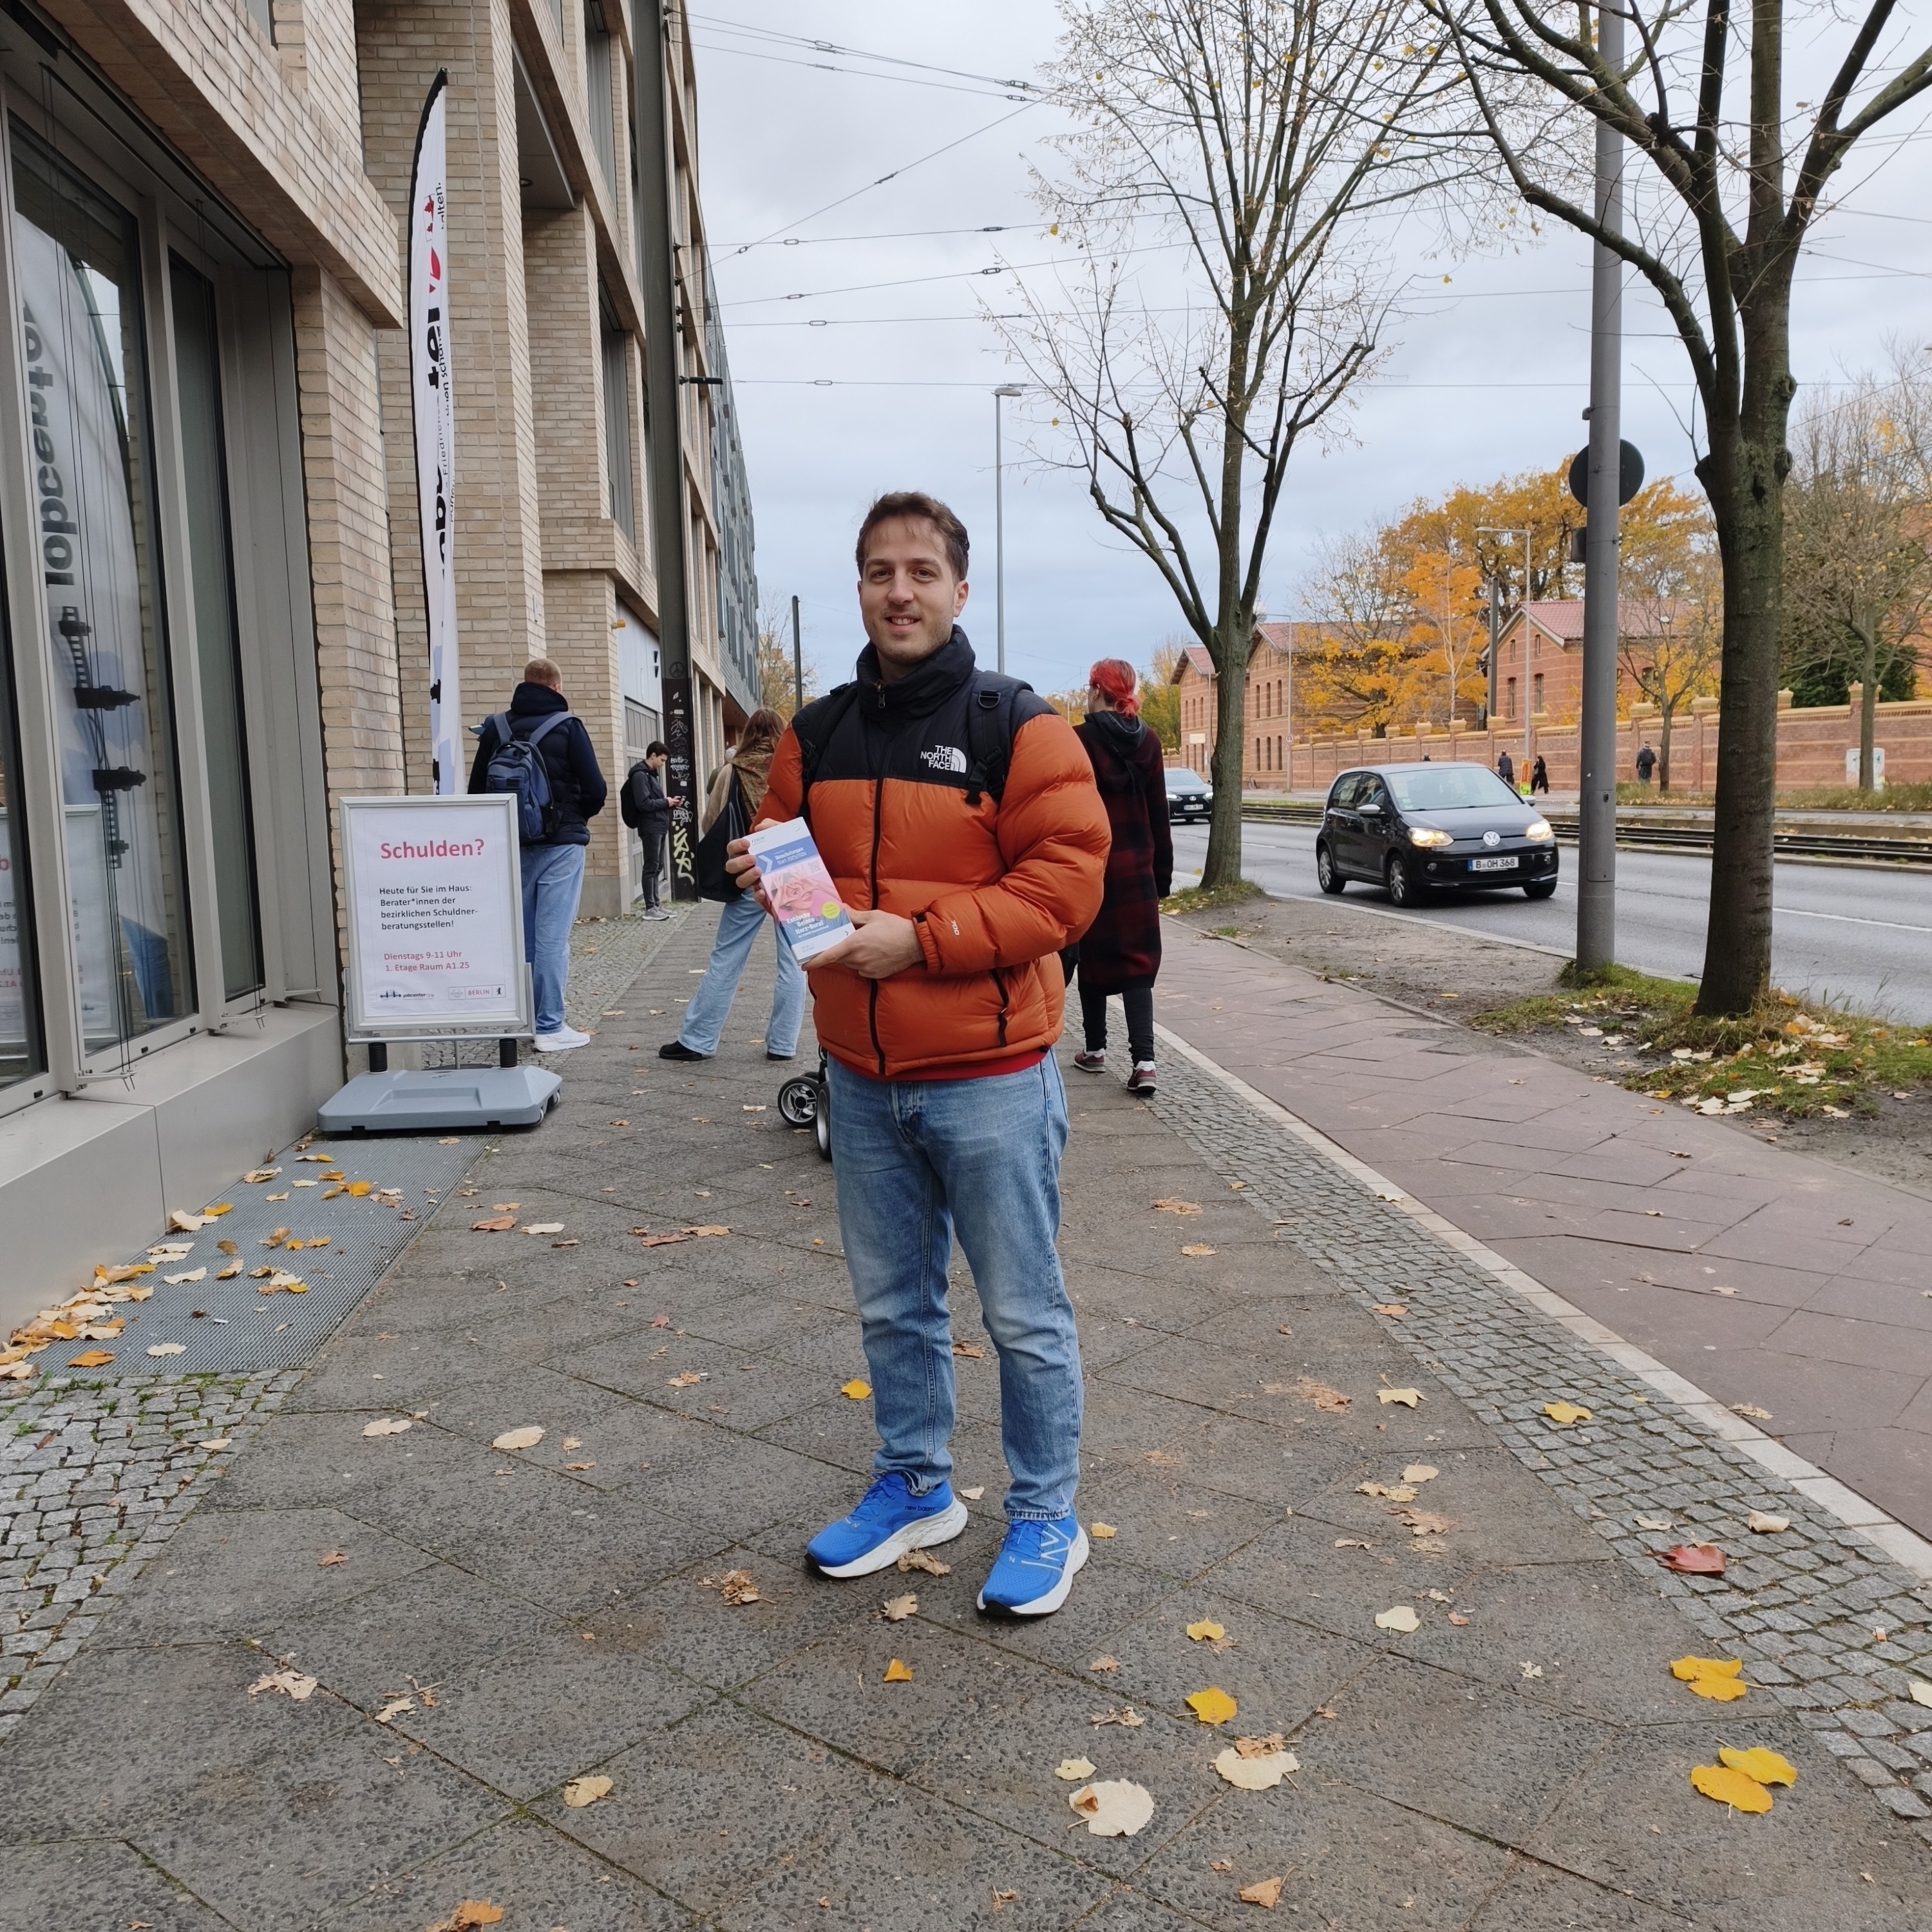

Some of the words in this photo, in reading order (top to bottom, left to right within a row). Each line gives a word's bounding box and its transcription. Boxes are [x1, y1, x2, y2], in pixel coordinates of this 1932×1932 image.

[935, 744, 952, 755] THE
[920, 751, 951, 762] NORTH
[929, 760, 951, 770] FACE
[381, 838, 484, 859] Schulden?
[1476, 860, 1481, 869] B
[1500, 858, 1515, 867] 368
[381, 909, 431, 918] bezirklichen
[381, 920, 454, 930] beratungsstellen!
[384, 952, 424, 961] Dienstags
[395, 964, 417, 972] Etage
[446, 961, 470, 970] A1.25
